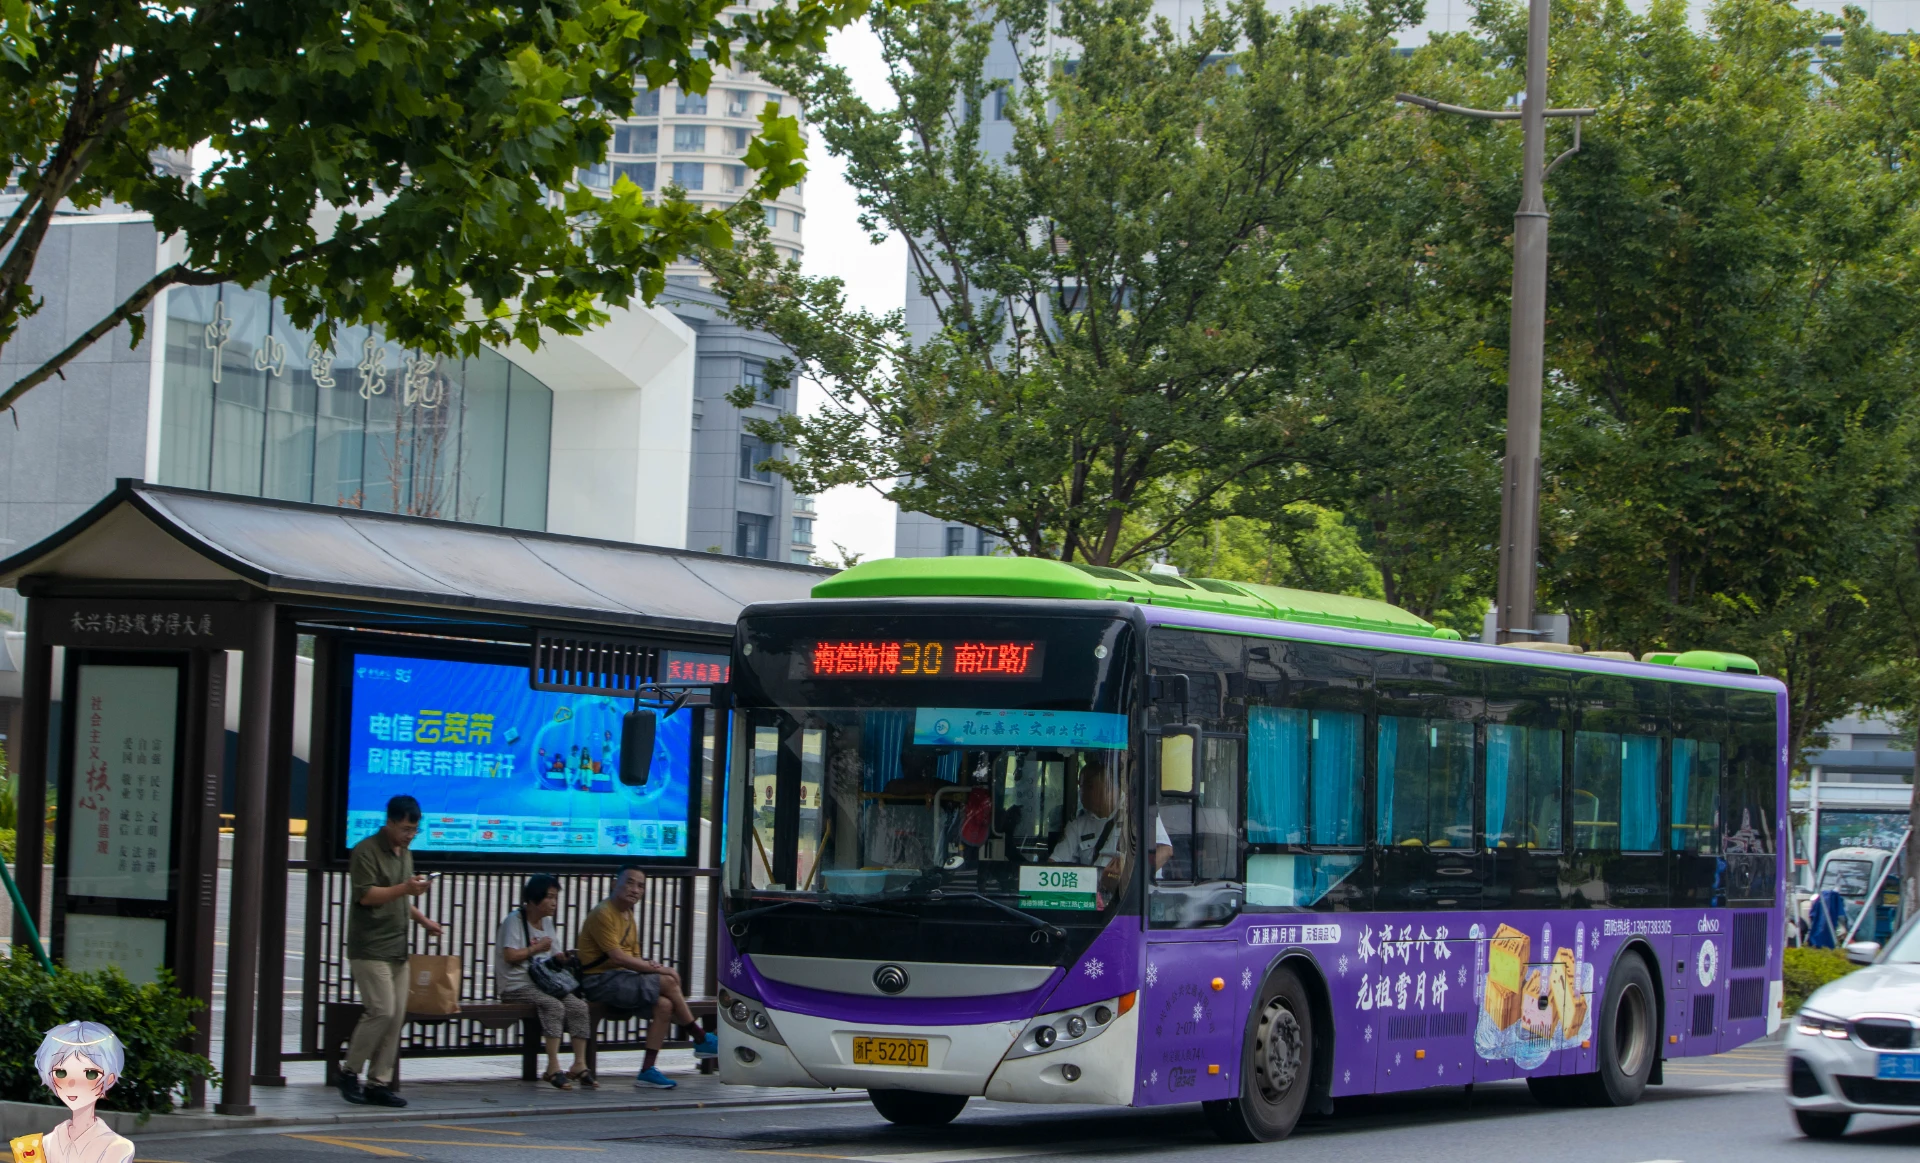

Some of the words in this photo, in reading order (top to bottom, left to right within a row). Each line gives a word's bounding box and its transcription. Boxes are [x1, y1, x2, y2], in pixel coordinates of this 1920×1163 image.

[813, 642, 900, 674] 海德饰博
[901, 642, 943, 674] 30
[368, 709, 496, 745] 电信云宽带
[1028, 721, 1087, 737] 文明出行
[1038, 871, 1078, 888] 30路
[1697, 912, 1720, 932] GANSO
[1252, 927, 1296, 944] 冰淇淋月饼
[1306, 927, 1329, 941] 元祖食品
[1357, 923, 1452, 966] 冰凉好个秋
[1355, 970, 1449, 1013] 元祖雪月饼
